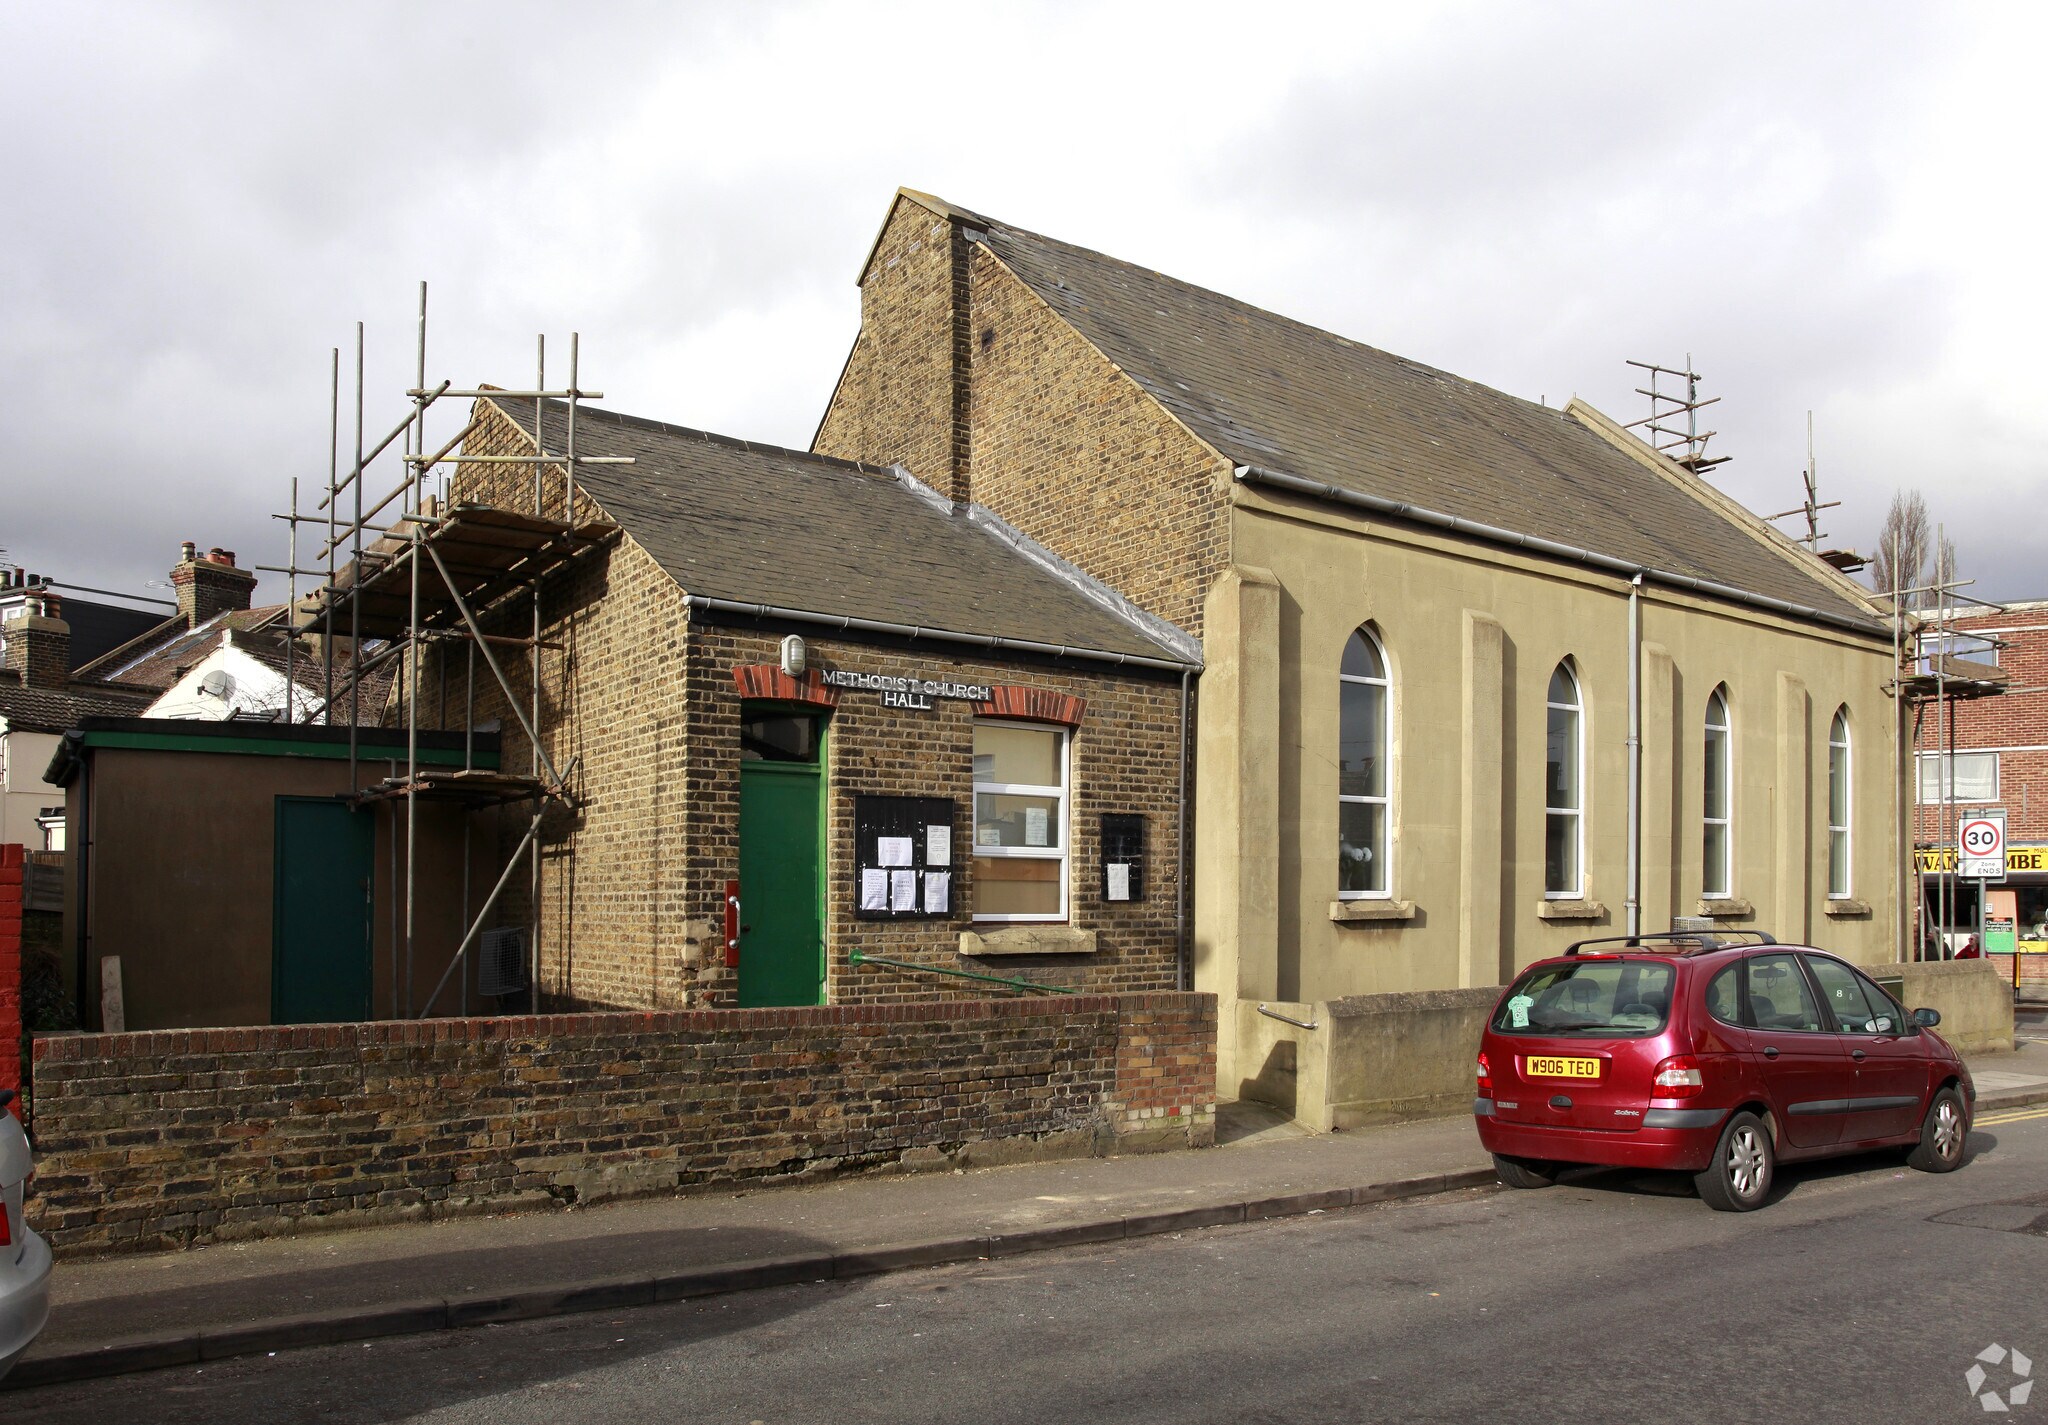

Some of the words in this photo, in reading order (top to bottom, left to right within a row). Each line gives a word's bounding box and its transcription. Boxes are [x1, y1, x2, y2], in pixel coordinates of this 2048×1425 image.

[822, 669, 919, 692] METHODIST
[924, 681, 991, 700] CHURCH
[885, 692, 931, 709] HALL
[1968, 831, 1994, 845] 30
[1978, 867, 2001, 875] ENDS
[1532, 1059, 1564, 1074] W906
[1567, 1060, 1594, 1076] TEO
